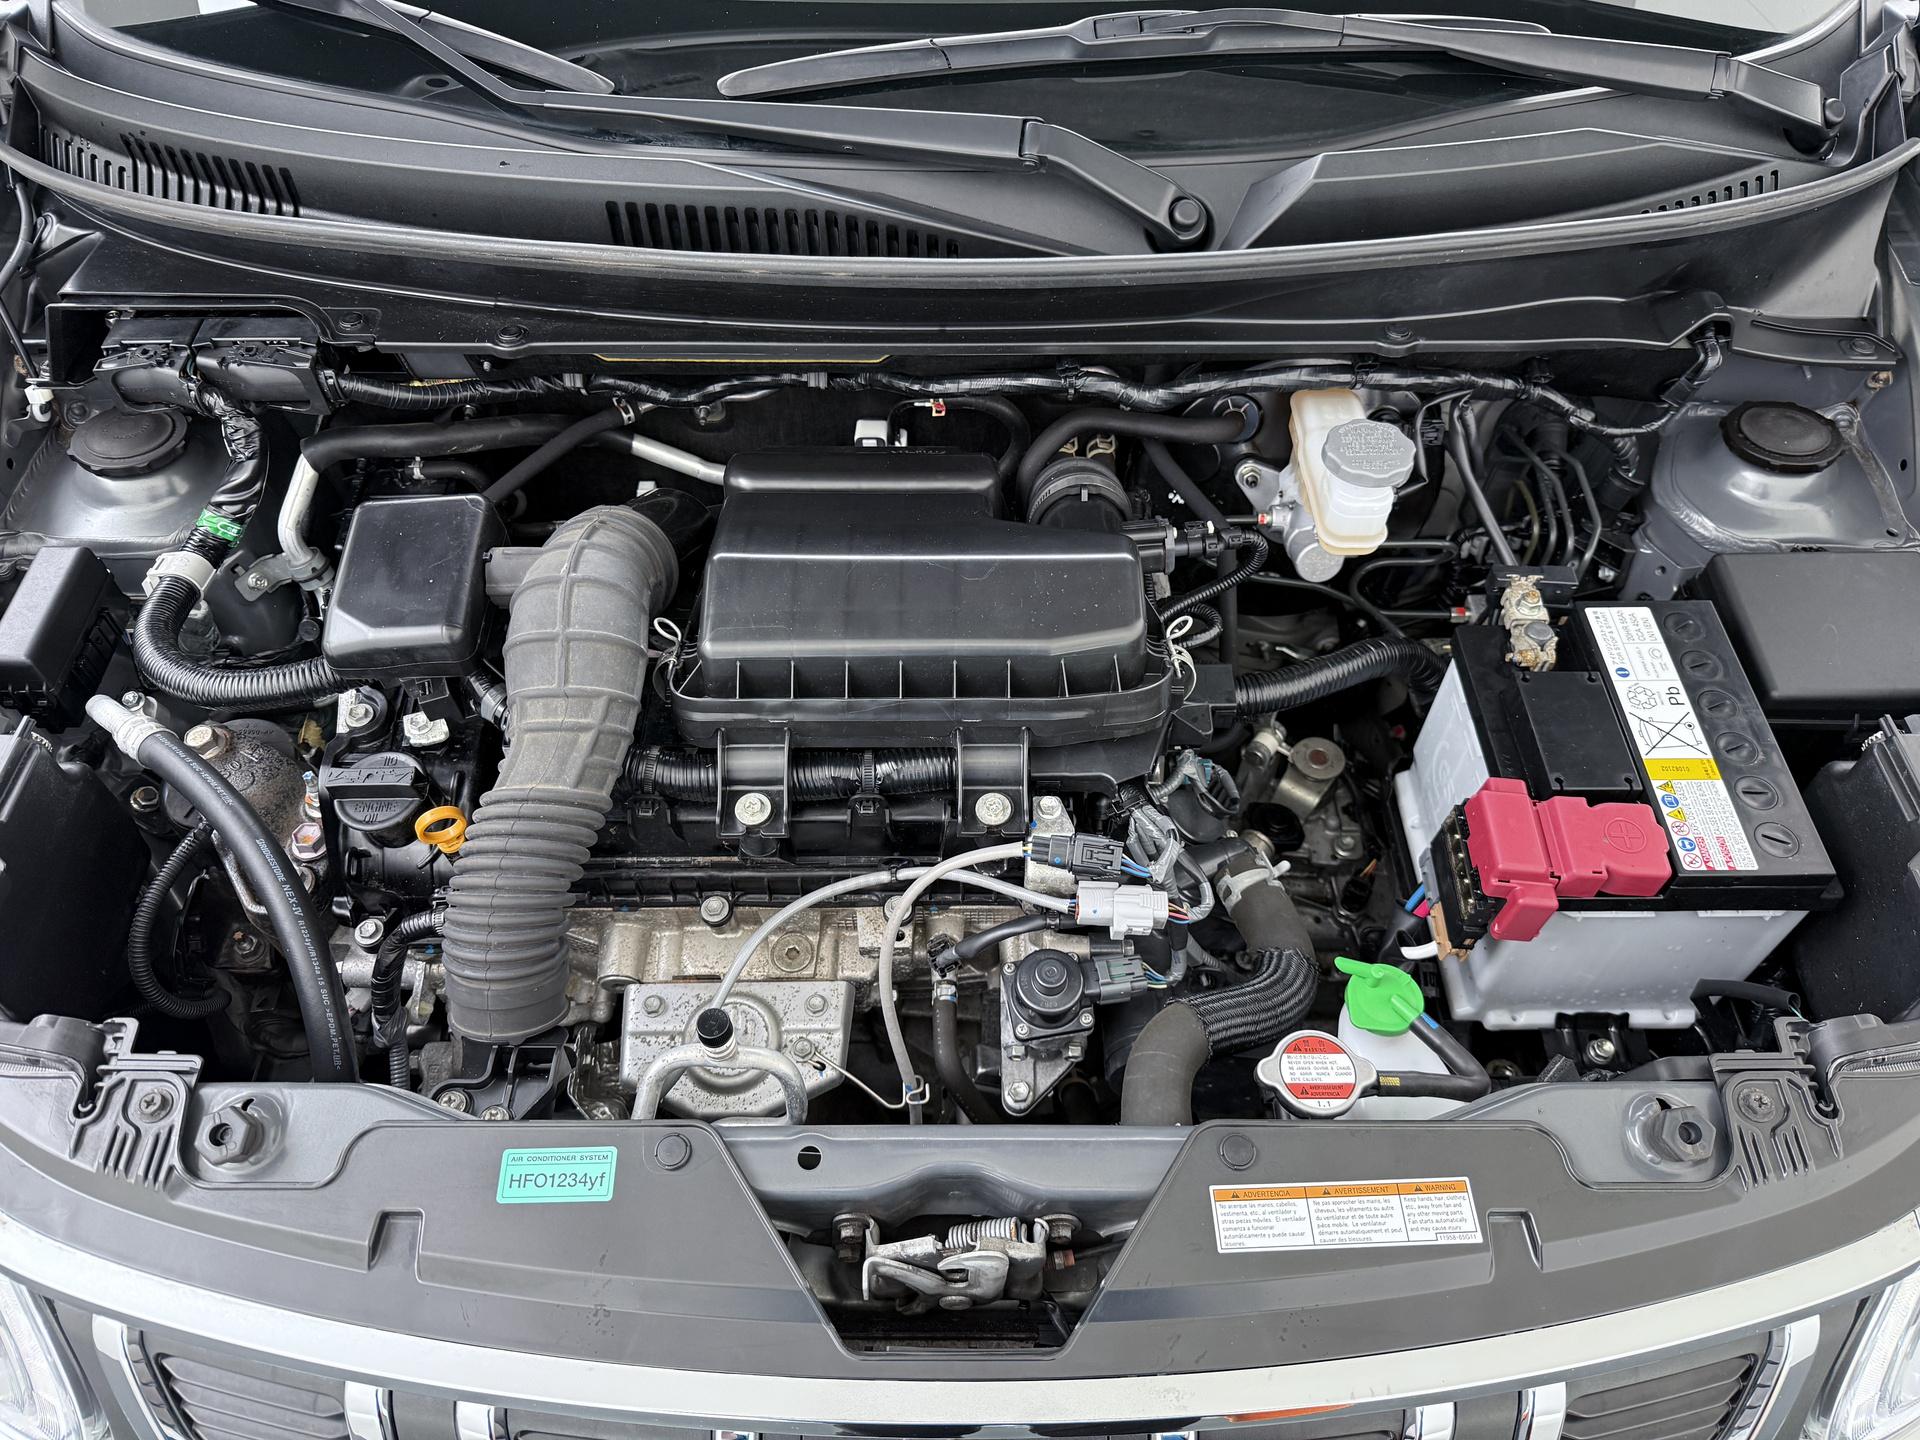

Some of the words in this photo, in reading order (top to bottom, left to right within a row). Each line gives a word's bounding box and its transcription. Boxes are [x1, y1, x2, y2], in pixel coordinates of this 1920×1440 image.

[1666, 686, 1685, 705] Pb
[256, 839, 286, 882] BRIDGESTONE
[282, 884, 303, 916] NEX-IV
[318, 977, 325, 985] 15
[321, 988, 330, 1005] SUC
[509, 1172, 606, 1191] HFO1234yf
[1334, 1186, 1389, 1194] AVERTISSEMENT
[1243, 1190, 1291, 1198] ADVERTENCIA
